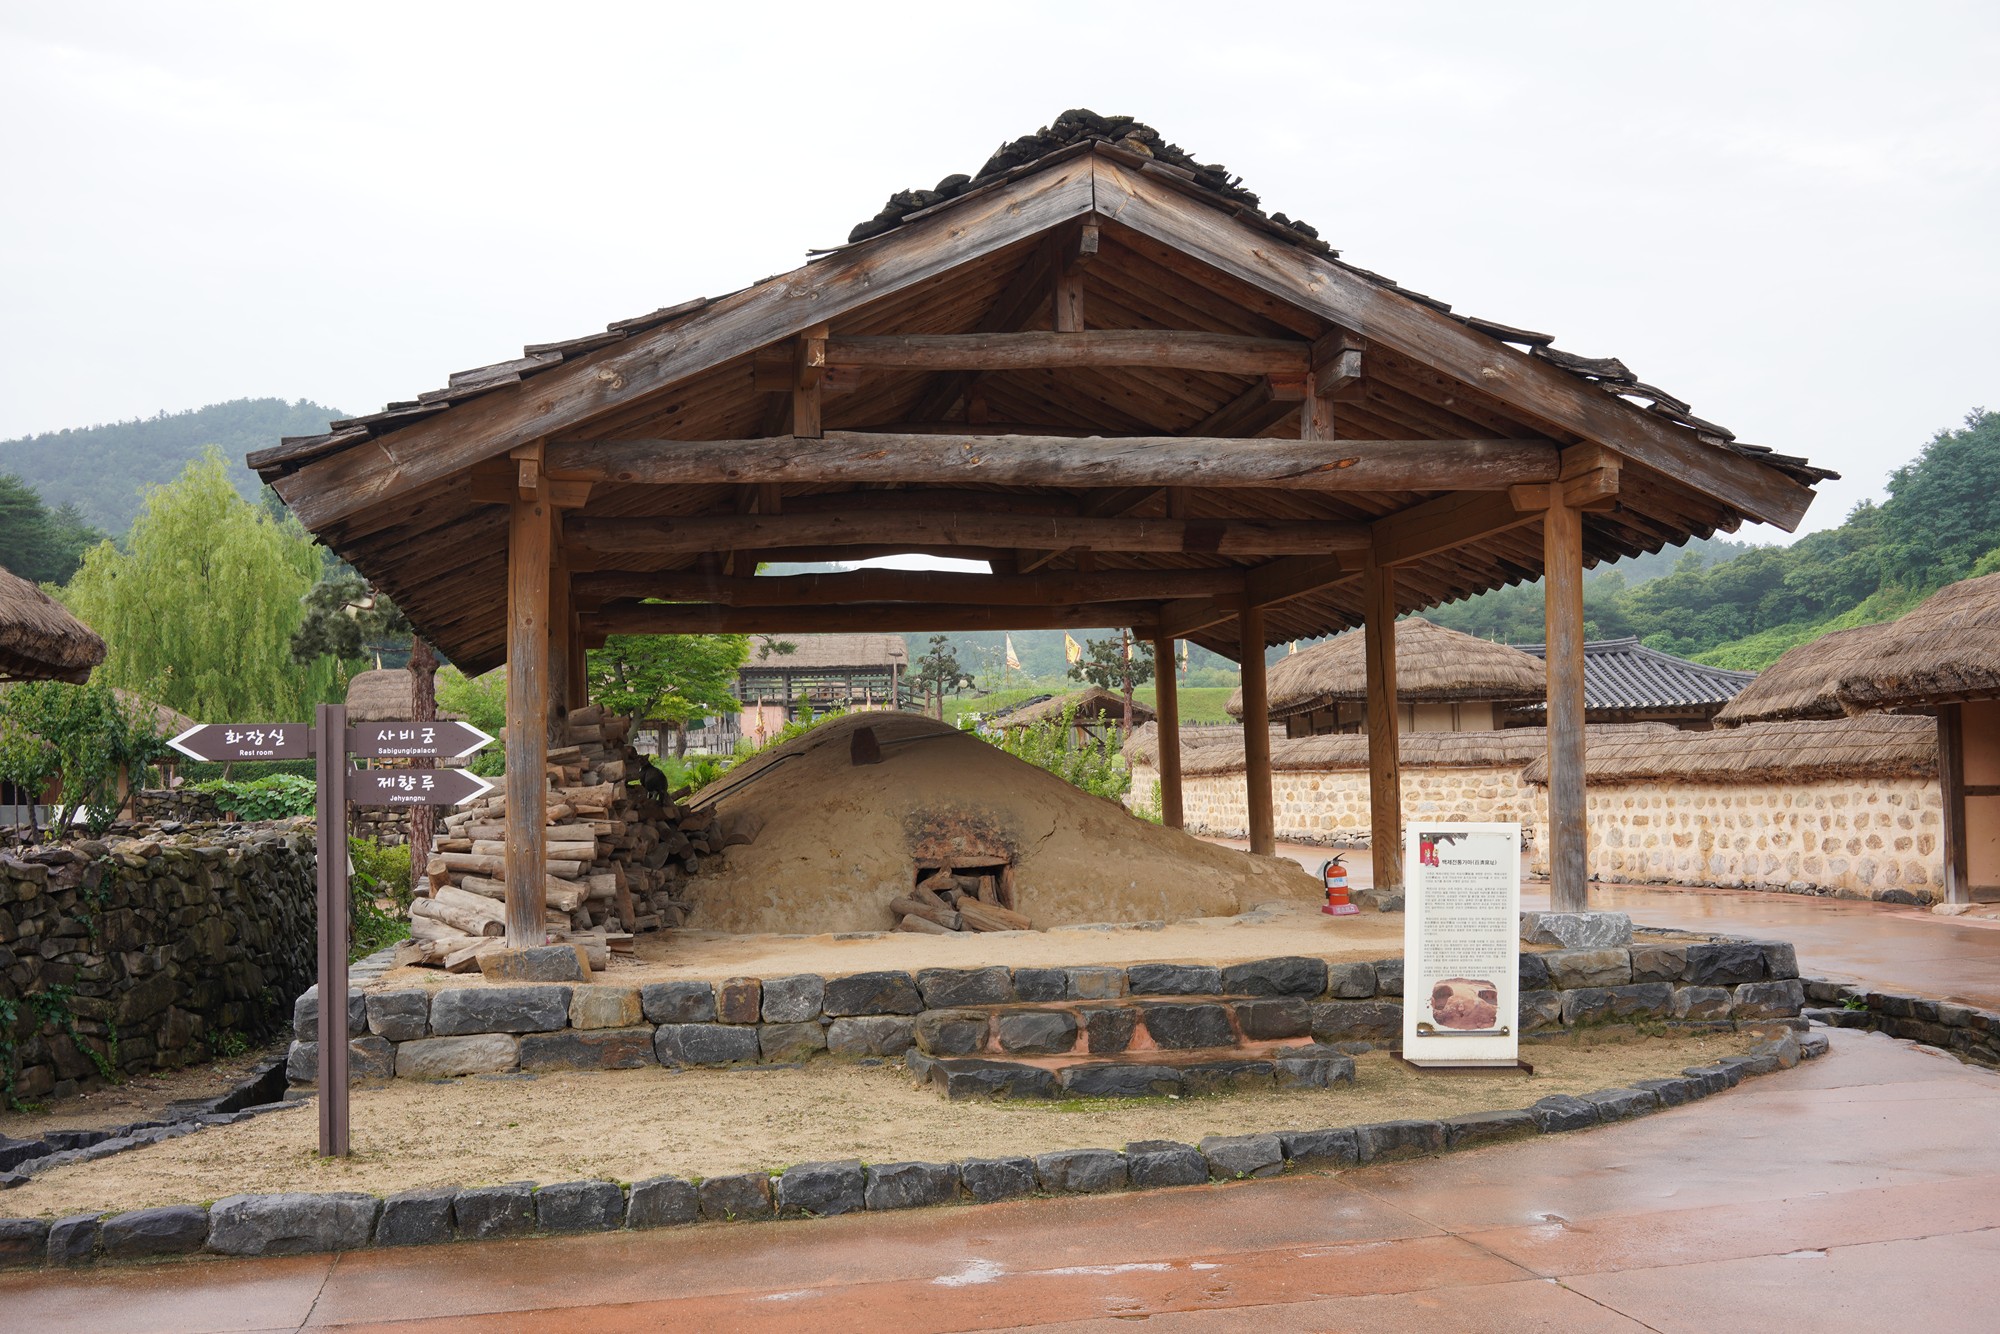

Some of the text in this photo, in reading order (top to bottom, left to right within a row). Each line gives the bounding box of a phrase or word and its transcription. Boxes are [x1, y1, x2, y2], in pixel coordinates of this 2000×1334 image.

[225, 729, 285, 746] 화장실
[377, 727, 436, 744] 사비궁
[378, 747, 438, 755] Sabigung(palace)
[377, 775, 435, 791] 제향루
